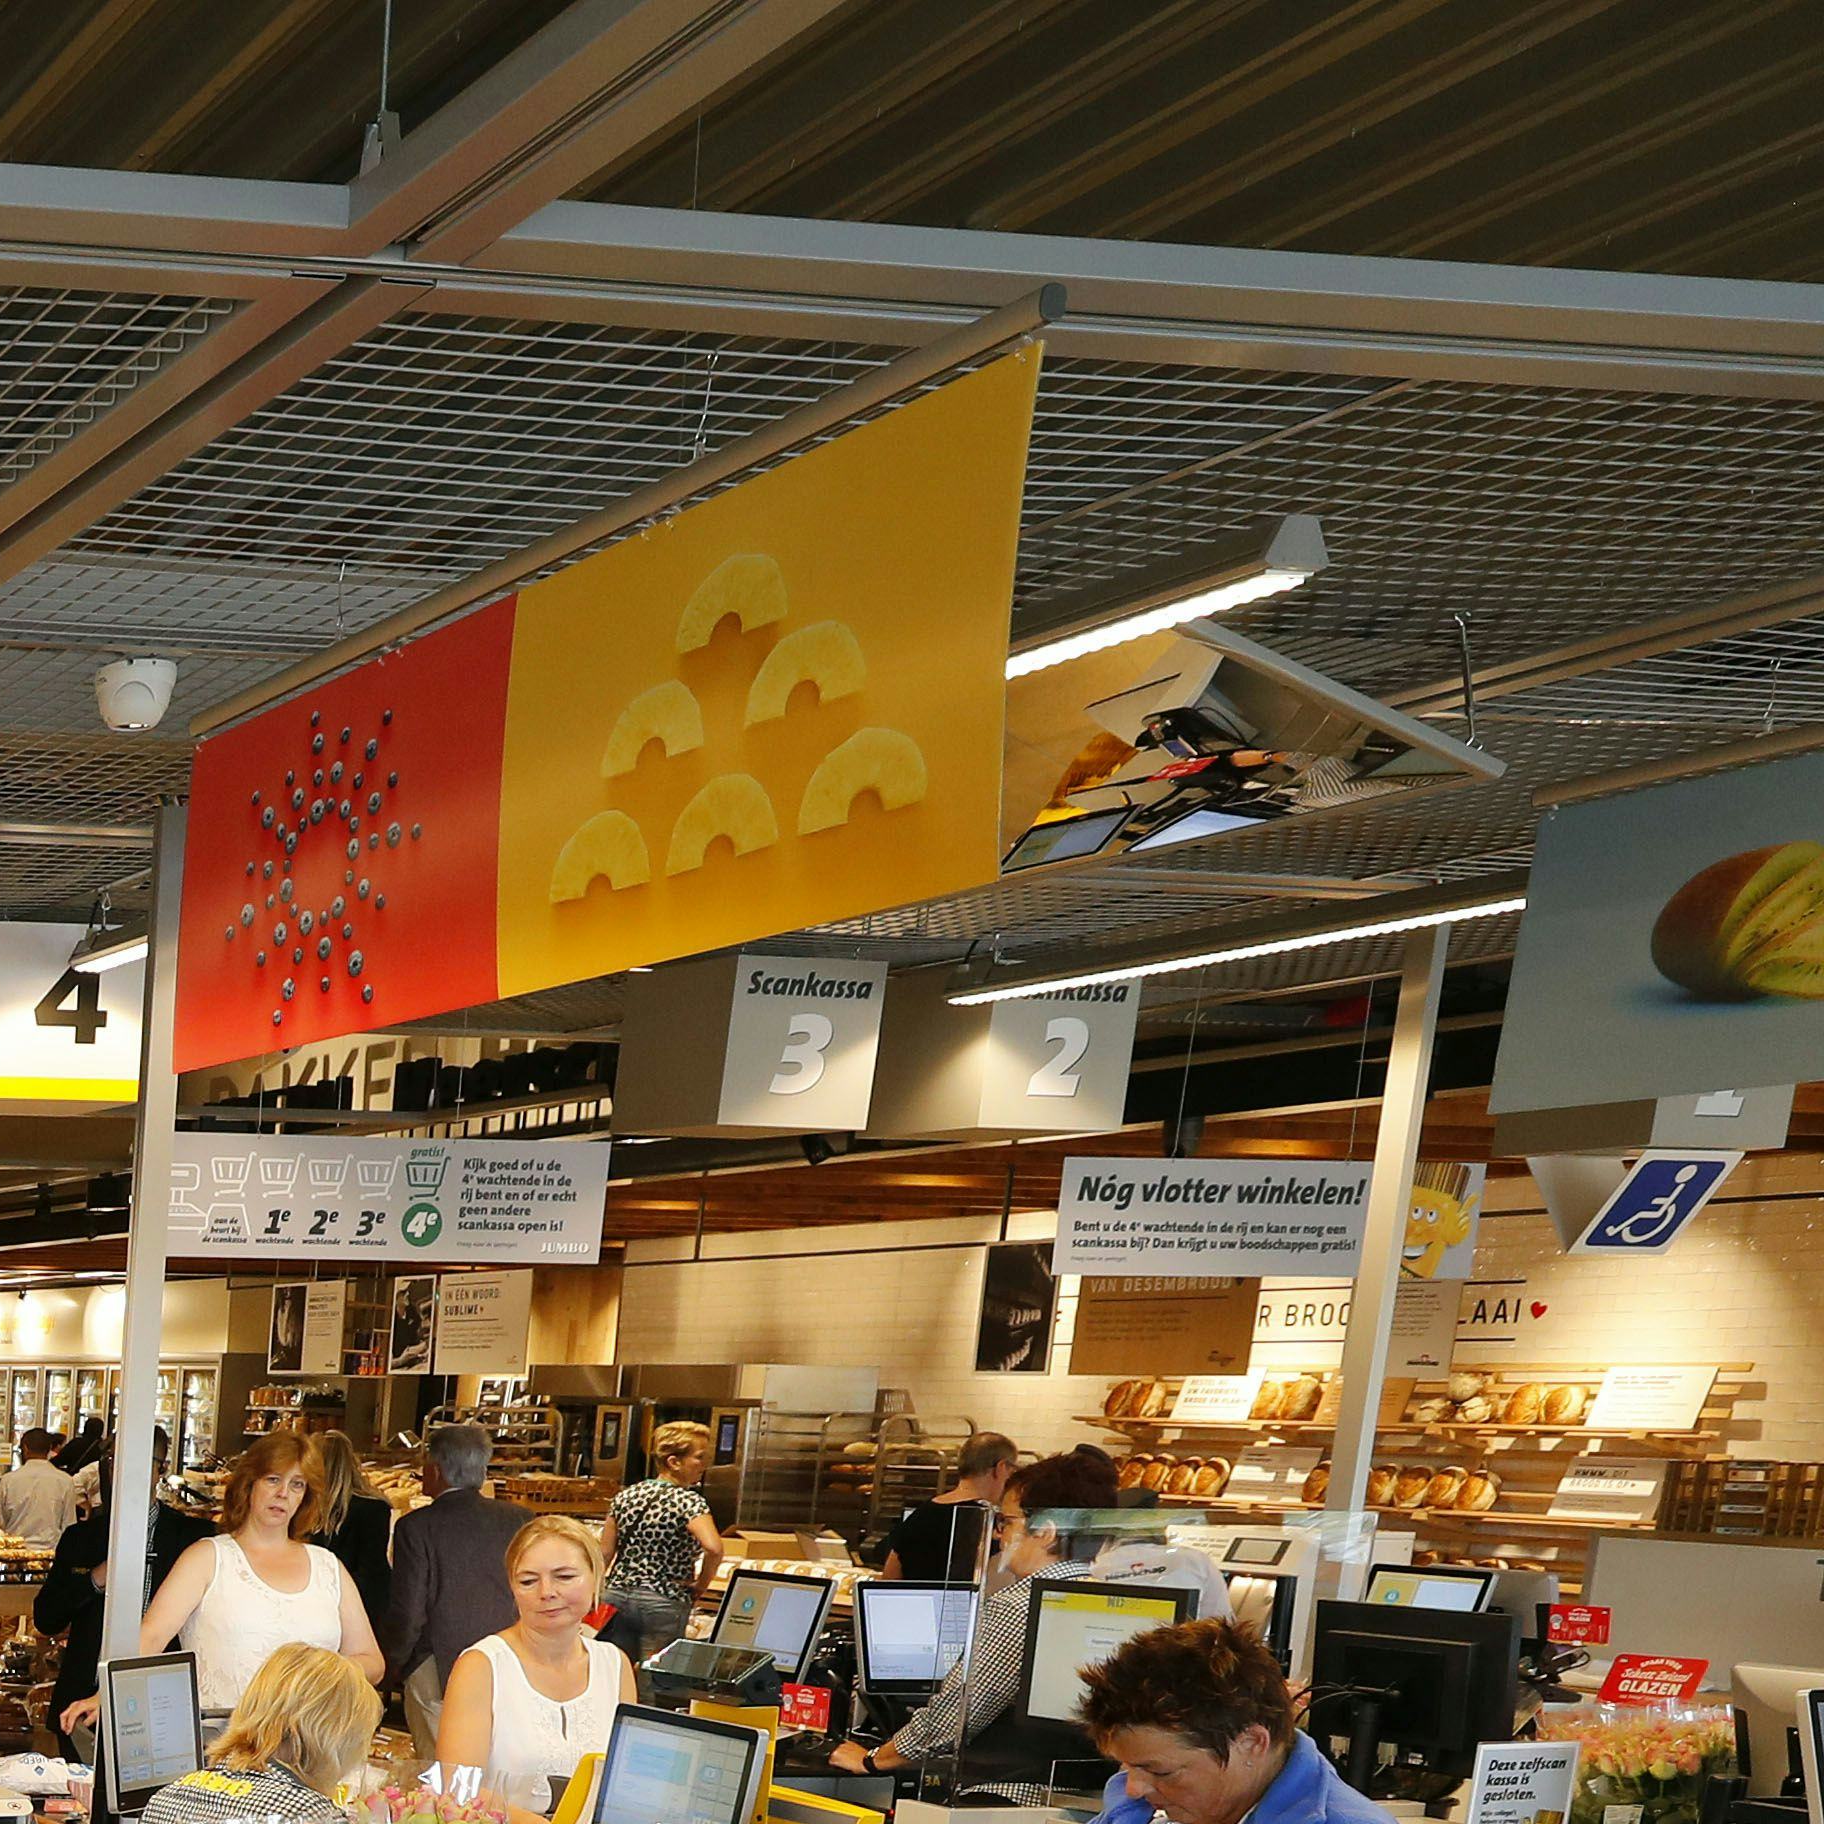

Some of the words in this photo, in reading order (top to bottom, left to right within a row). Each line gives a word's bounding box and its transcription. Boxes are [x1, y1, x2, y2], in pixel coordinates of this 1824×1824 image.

[748, 969, 873, 1000] Scankassa
[34, 960, 107, 1044] 4
[768, 1012, 832, 1095] 3
[1027, 1017, 1090, 1097] 2
[463, 1158, 486, 1173] Kijk
[489, 1159, 519, 1173] goed
[521, 1159, 534, 1171] of
[536, 1163, 544, 1171] u
[546, 1160, 561, 1171] de
[476, 1174, 541, 1186] wachtende
[543, 1175, 554, 1186] in
[557, 1176, 572, 1187] de
[460, 1187, 473, 1203] rij
[475, 1189, 502, 1200] bent
[505, 1192, 519, 1200] en
[522, 1190, 535, 1200] of
[537, 1193, 549, 1201] er
[552, 1190, 577, 1201] echt
[1077, 1174, 1135, 1210] Nóg
[1142, 1176, 1232, 1204] vlotter
[1237, 1176, 1367, 1205] winkelen!
[459, 1207, 488, 1218] geen
[490, 1205, 531, 1216] andere
[457, 1219, 515, 1231] scankassa
[517, 1223, 547, 1234] open
[549, 1221, 563, 1232] is!
[1073, 1220, 1101, 1232] Bent
[1103, 1224, 1111, 1232] u
[1113, 1221, 1127, 1232] de
[1143, 1222, 1204, 1233] wachtende
[1207, 1222, 1217, 1233] in
[1220, 1222, 1234, 1233] de
[1235, 1223, 1249, 1237] rij
[1250, 1226, 1264, 1234] en
[1266, 1223, 1287, 1234] kan
[1289, 1226, 1301, 1234] er
[1303, 1226, 1324, 1237] nog
[1327, 1226, 1346, 1234] een
[540, 1242, 590, 1254] JUMBO
[1071, 1237, 1127, 1248] scankassa
[1130, 1237, 1150, 1251] bij?
[1152, 1238, 1174, 1248] Dan
[1177, 1238, 1207, 1252] krijgt
[1239, 1239, 1318, 1252] boodschappen
[1320, 1239, 1356, 1252] gratis!
[1618, 1680, 1682, 1696] GLAZEN
[1488, 1758, 1517, 1771] Deze
[1519, 1757, 1567, 1774] zelfscan
[924, 1774, 940, 1786] 3A
[1486, 1775, 1519, 1787] kassa
[1521, 1775, 1530, 1786] is
[1483, 1788, 1536, 1804] gesloten.
